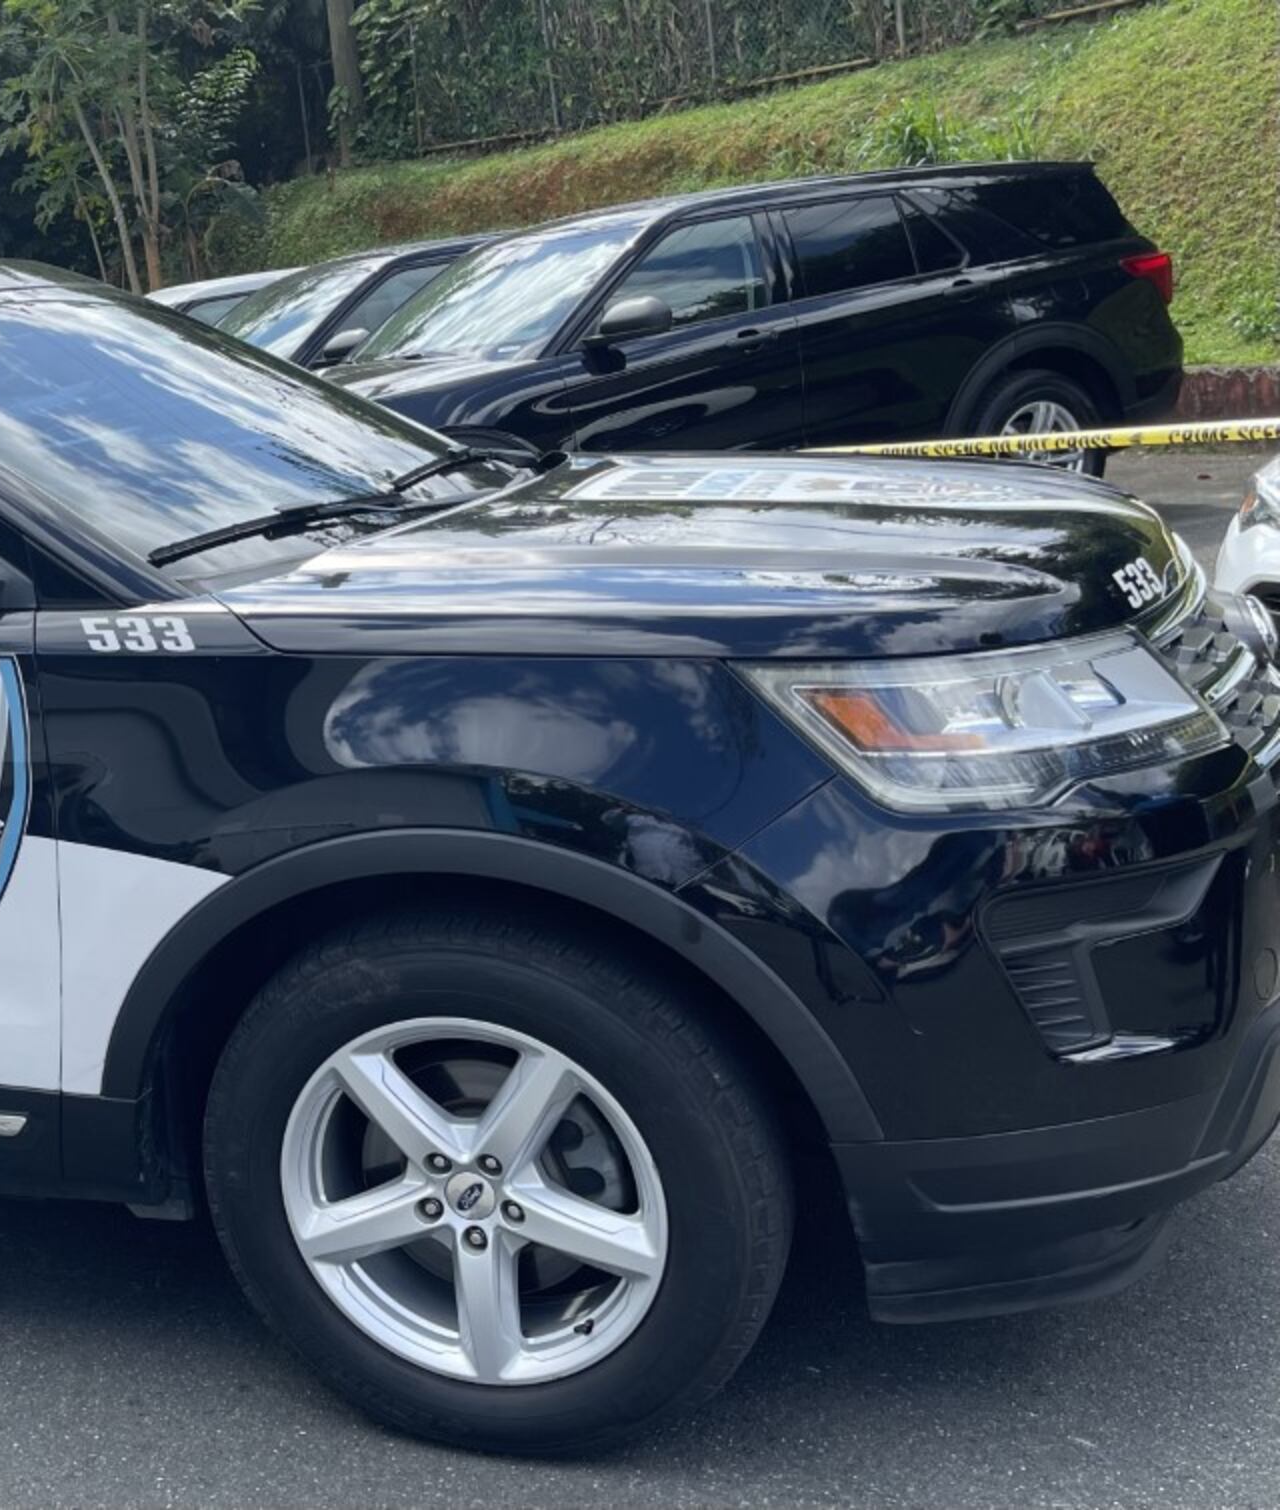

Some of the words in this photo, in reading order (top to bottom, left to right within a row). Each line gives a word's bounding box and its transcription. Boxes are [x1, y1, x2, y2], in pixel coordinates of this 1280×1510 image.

[1055, 433, 1113, 449] CROSS
[1168, 428, 1230, 444] CRIME
[1238, 424, 1280, 441] SCE
[1112, 557, 1163, 608] 533
[80, 617, 196, 652] 533
